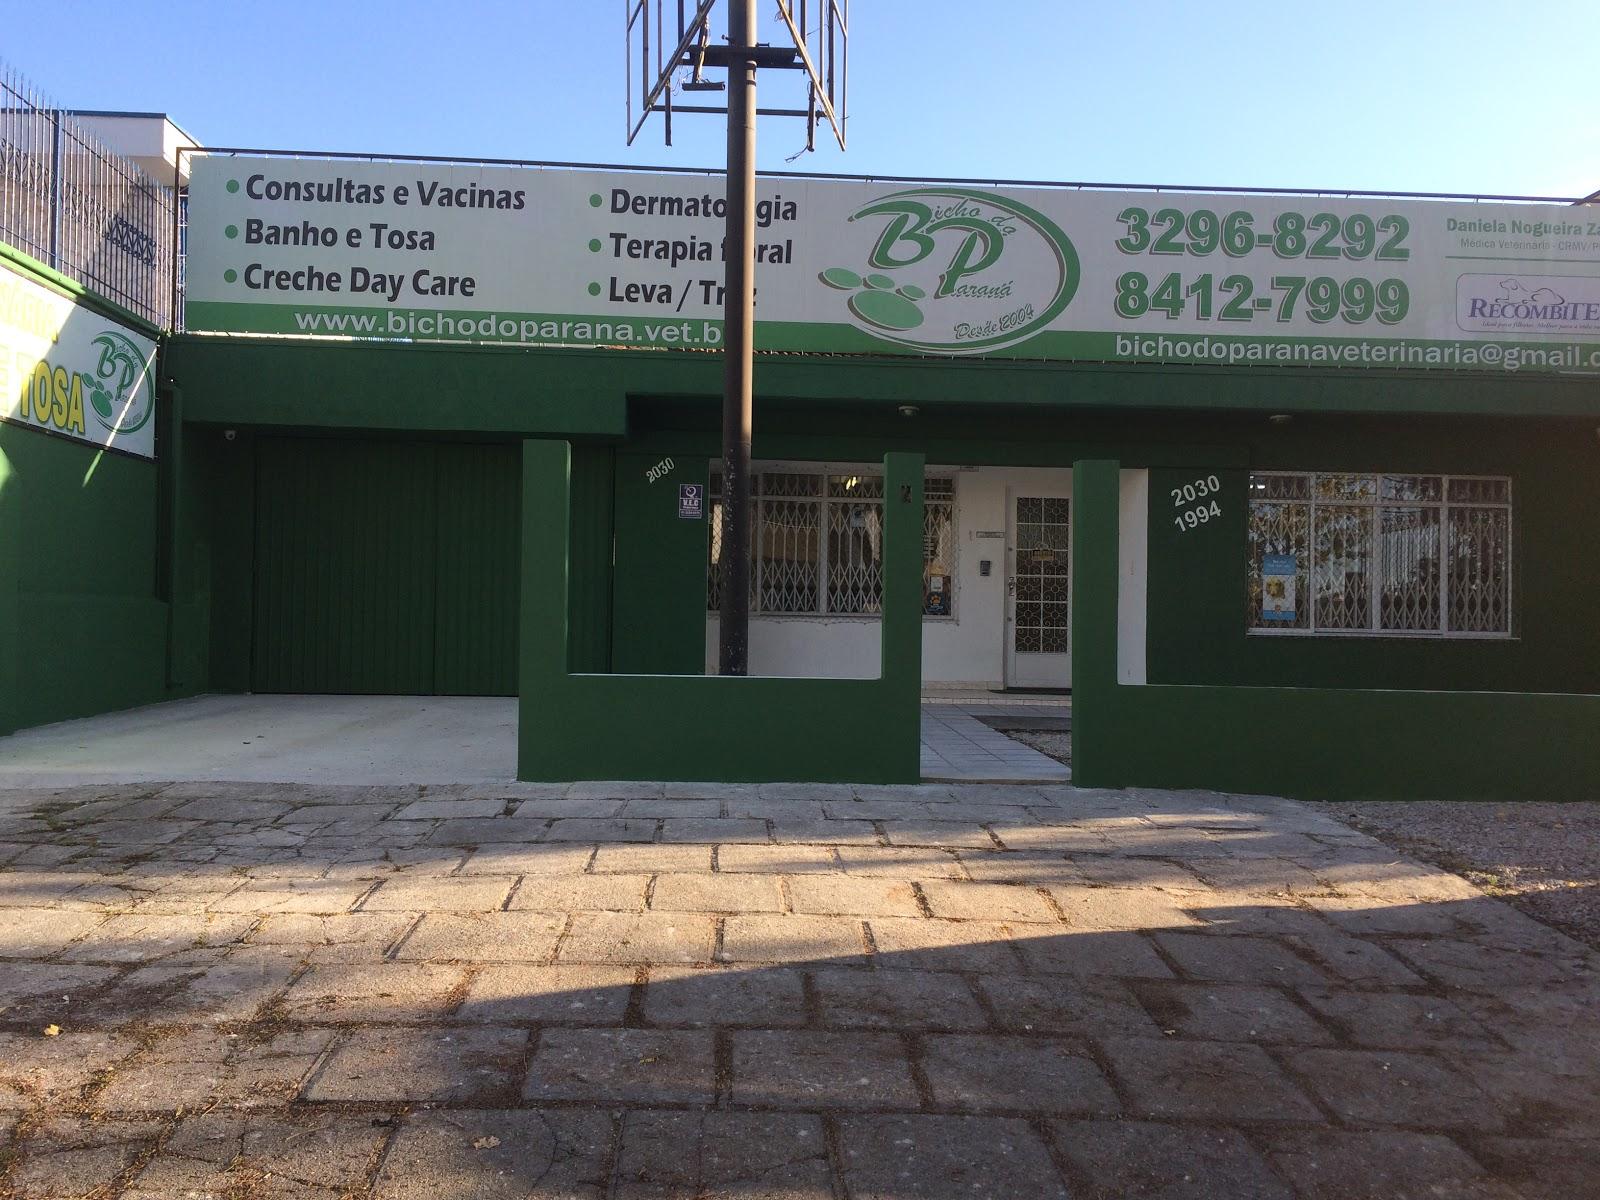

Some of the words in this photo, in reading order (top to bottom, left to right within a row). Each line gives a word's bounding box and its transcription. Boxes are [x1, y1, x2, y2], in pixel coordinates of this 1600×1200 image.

[246, 174, 385, 206] Consultas
[393, 185, 409, 206] e
[416, 181, 526, 211] Vacinas
[610, 188, 798, 228] Dermatogia
[245, 218, 338, 248] Banho
[346, 228, 362, 249] e
[370, 223, 436, 251] Tosa
[1115, 207, 1410, 262] 3296-8292
[1447, 218, 1507, 233] Daniela
[1511, 219, 1582, 237] Nogueira
[609, 232, 713, 268] Terapia
[244, 263, 342, 293] Creche
[350, 267, 405, 302] Day
[412, 269, 476, 297] Care
[609, 276, 673, 304] Leva
[1113, 271, 1410, 326] 8412-7999
[294, 311, 724, 344] www.bichodoparana.vet.b
[646, 458, 675, 484] 2030
[1170, 474, 1220, 507] 2030
[1174, 500, 1222, 532] 1994
